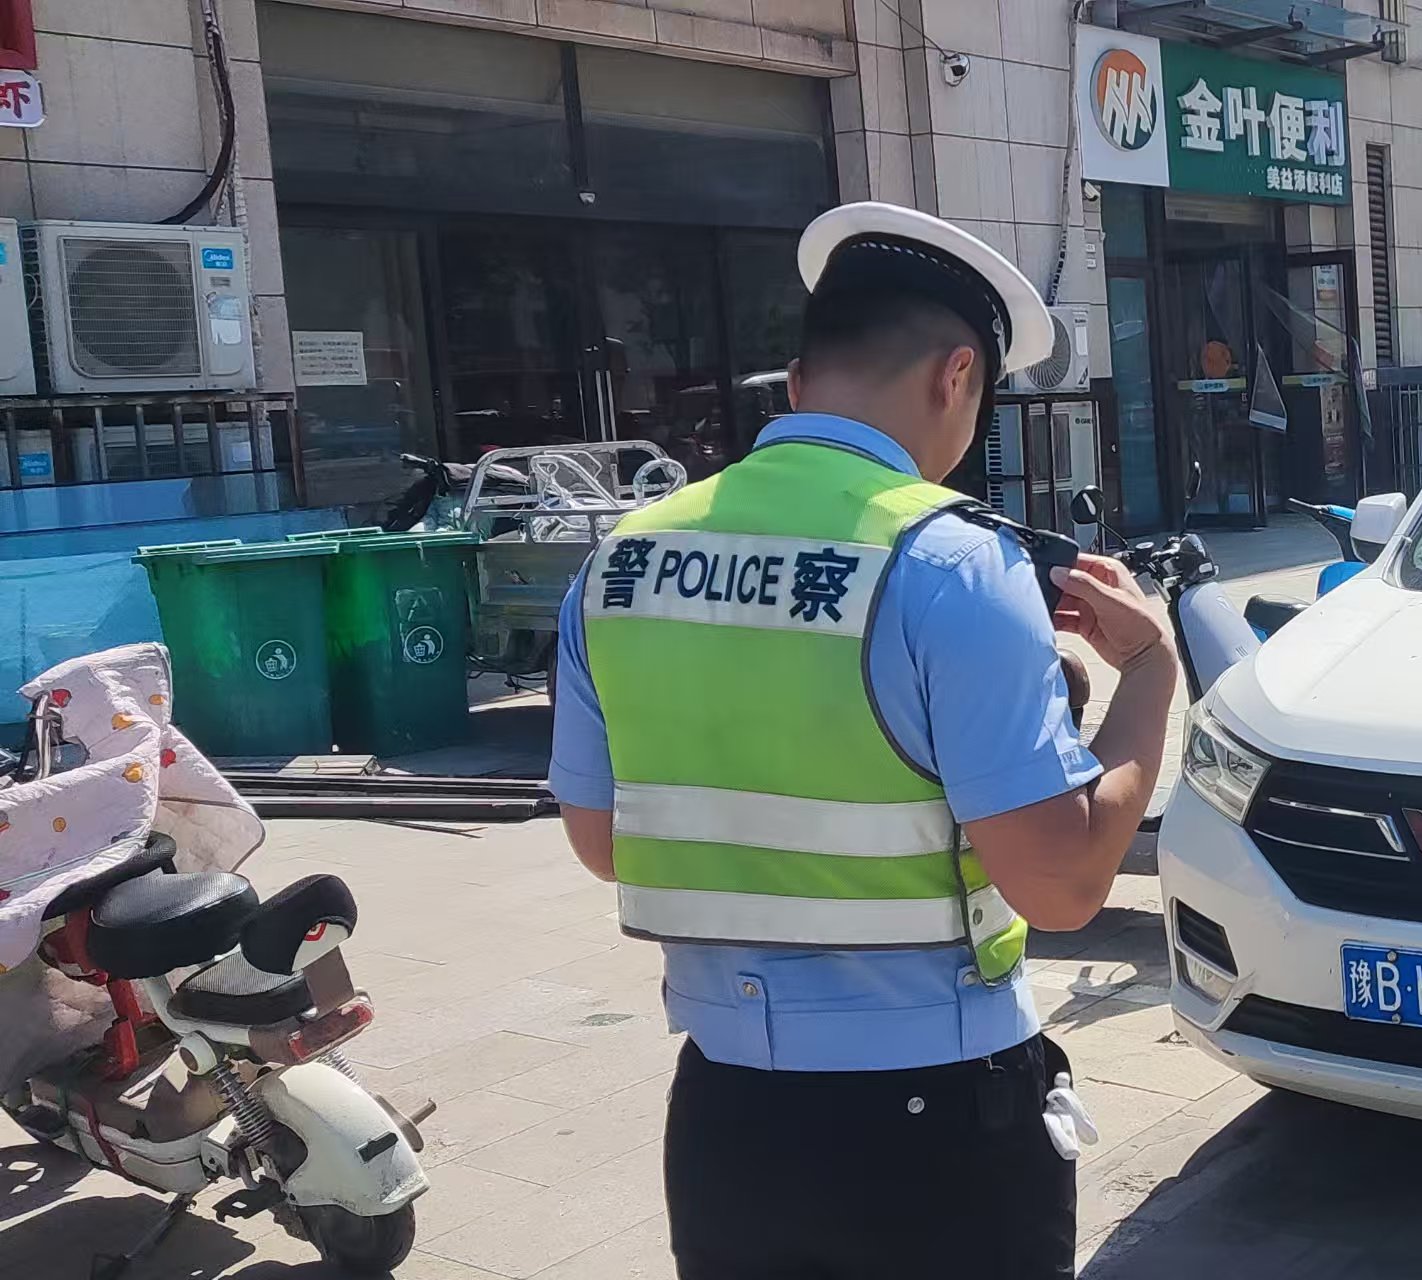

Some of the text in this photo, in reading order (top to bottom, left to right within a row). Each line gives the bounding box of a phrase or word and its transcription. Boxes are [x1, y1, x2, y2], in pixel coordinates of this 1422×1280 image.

[1177, 77, 1346, 166] 金叶便利
[601, 537, 860, 623] 警 POLICE 察
